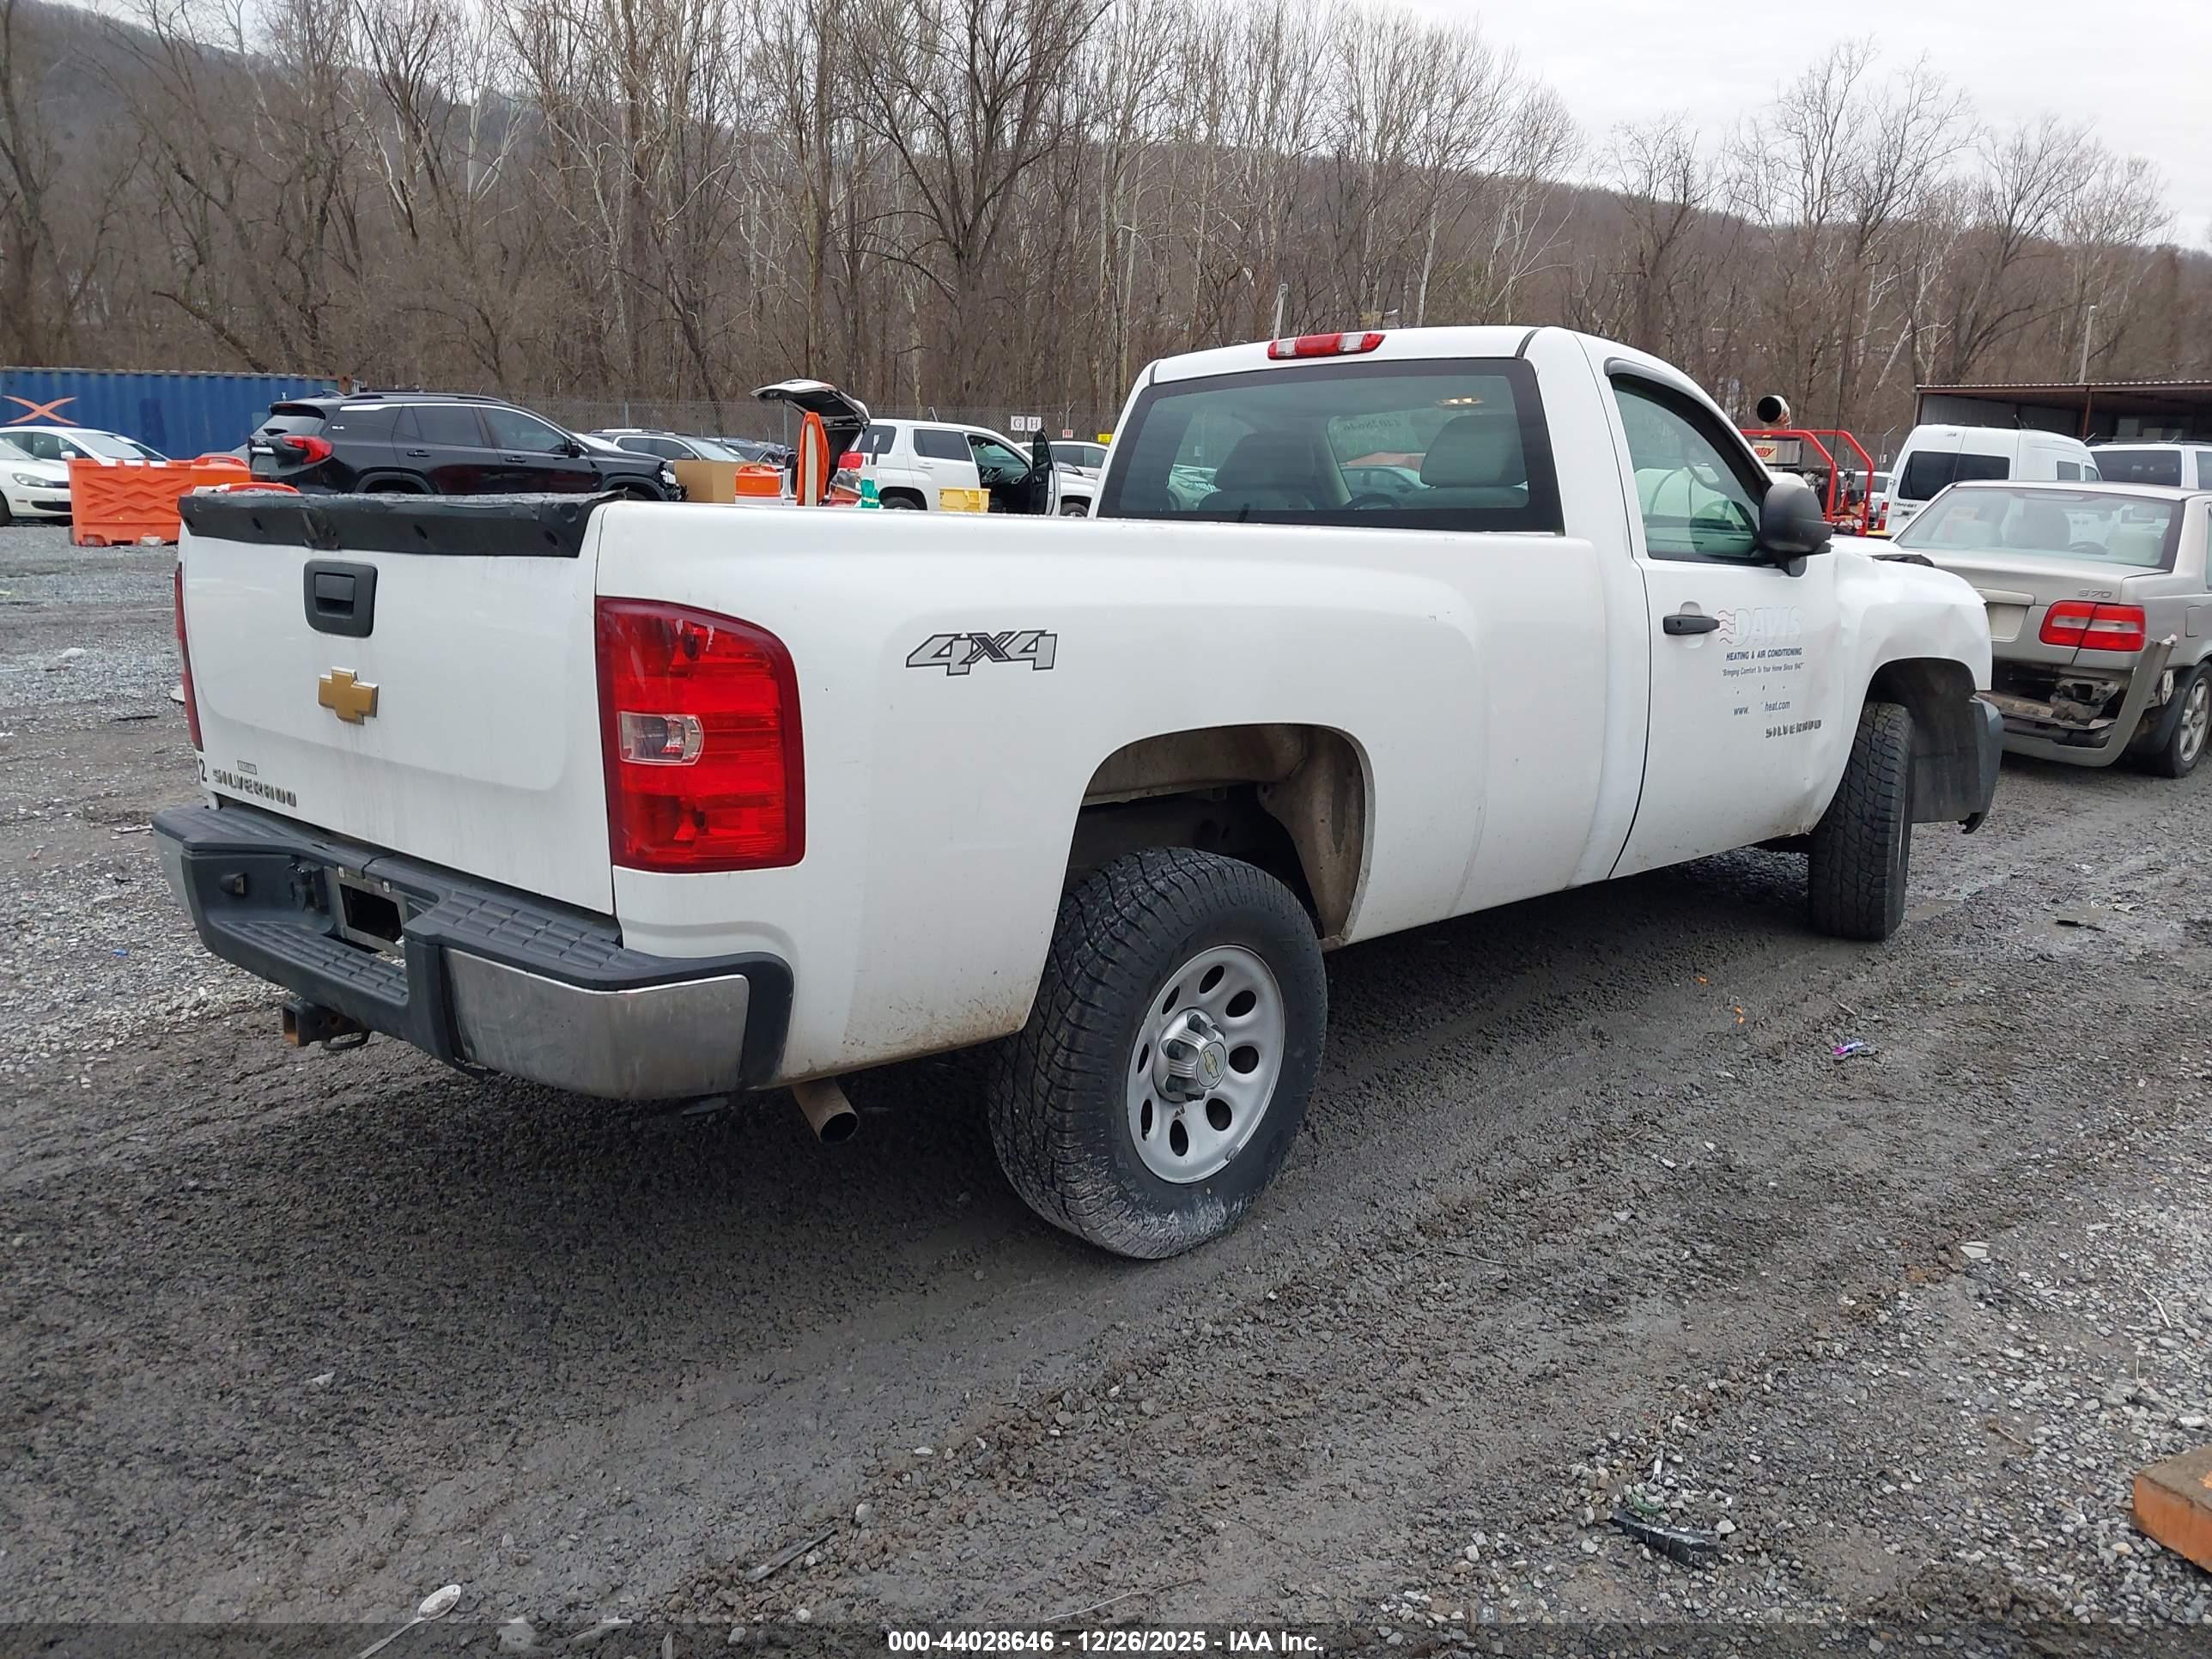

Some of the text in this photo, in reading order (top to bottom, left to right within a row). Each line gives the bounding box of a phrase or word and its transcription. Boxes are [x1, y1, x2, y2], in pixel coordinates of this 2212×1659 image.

[1013, 418, 1039, 429] G H
[2077, 589, 2113, 599] S70
[1725, 647, 1802, 661] HEATING & AIR CONDITIONING
[1765, 719, 1822, 739] SILVERADO
[212, 768, 297, 807] SILVERADO
